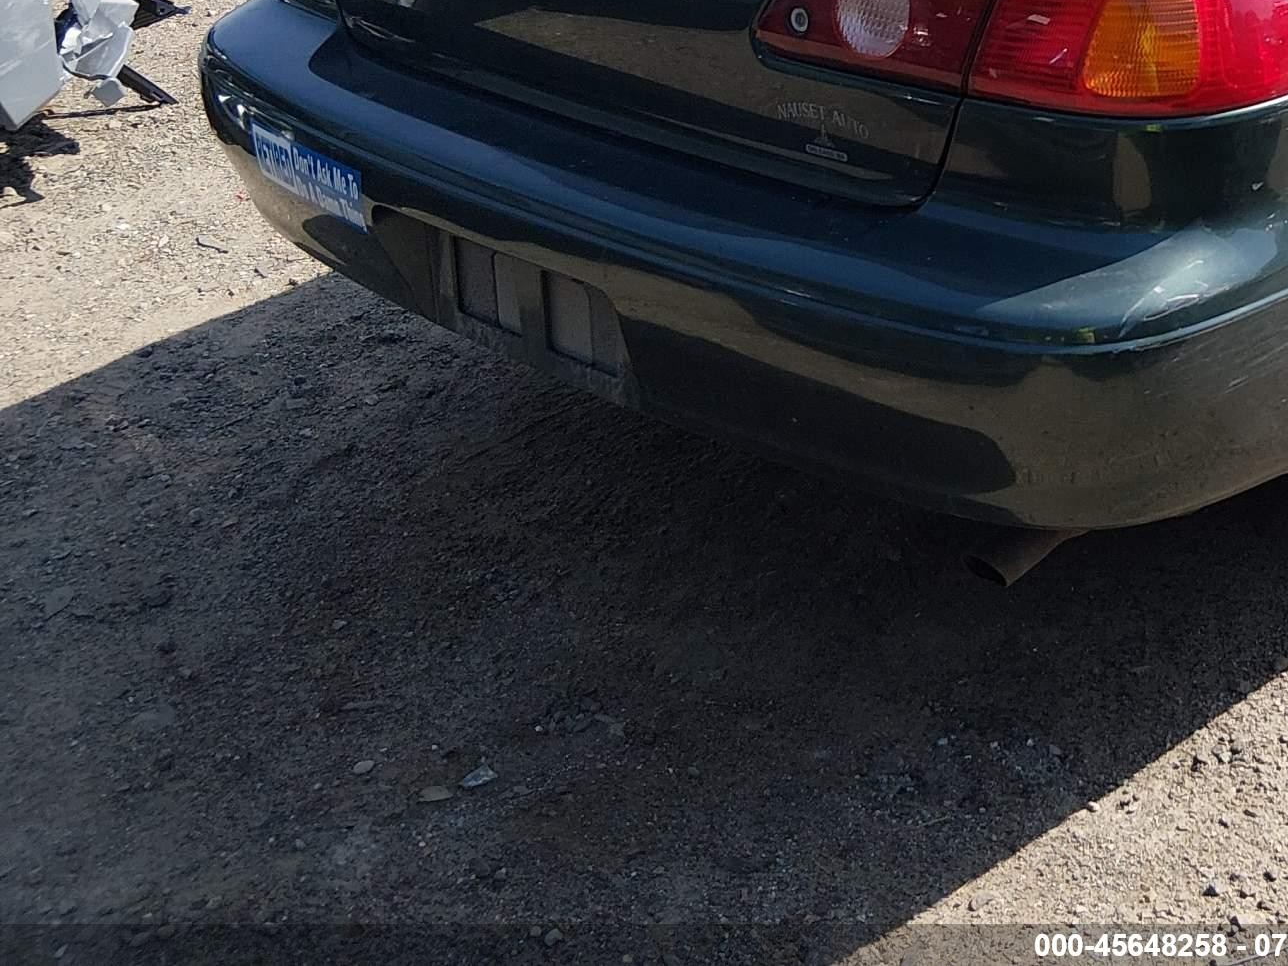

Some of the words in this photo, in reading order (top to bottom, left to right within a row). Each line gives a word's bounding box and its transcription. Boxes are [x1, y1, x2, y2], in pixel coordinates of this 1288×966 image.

[777, 101, 826, 121] NAUSET
[292, 146, 316, 181] Don't
[316, 158, 333, 189] Ask
[332, 165, 348, 196] Me
[347, 173, 360, 201] To
